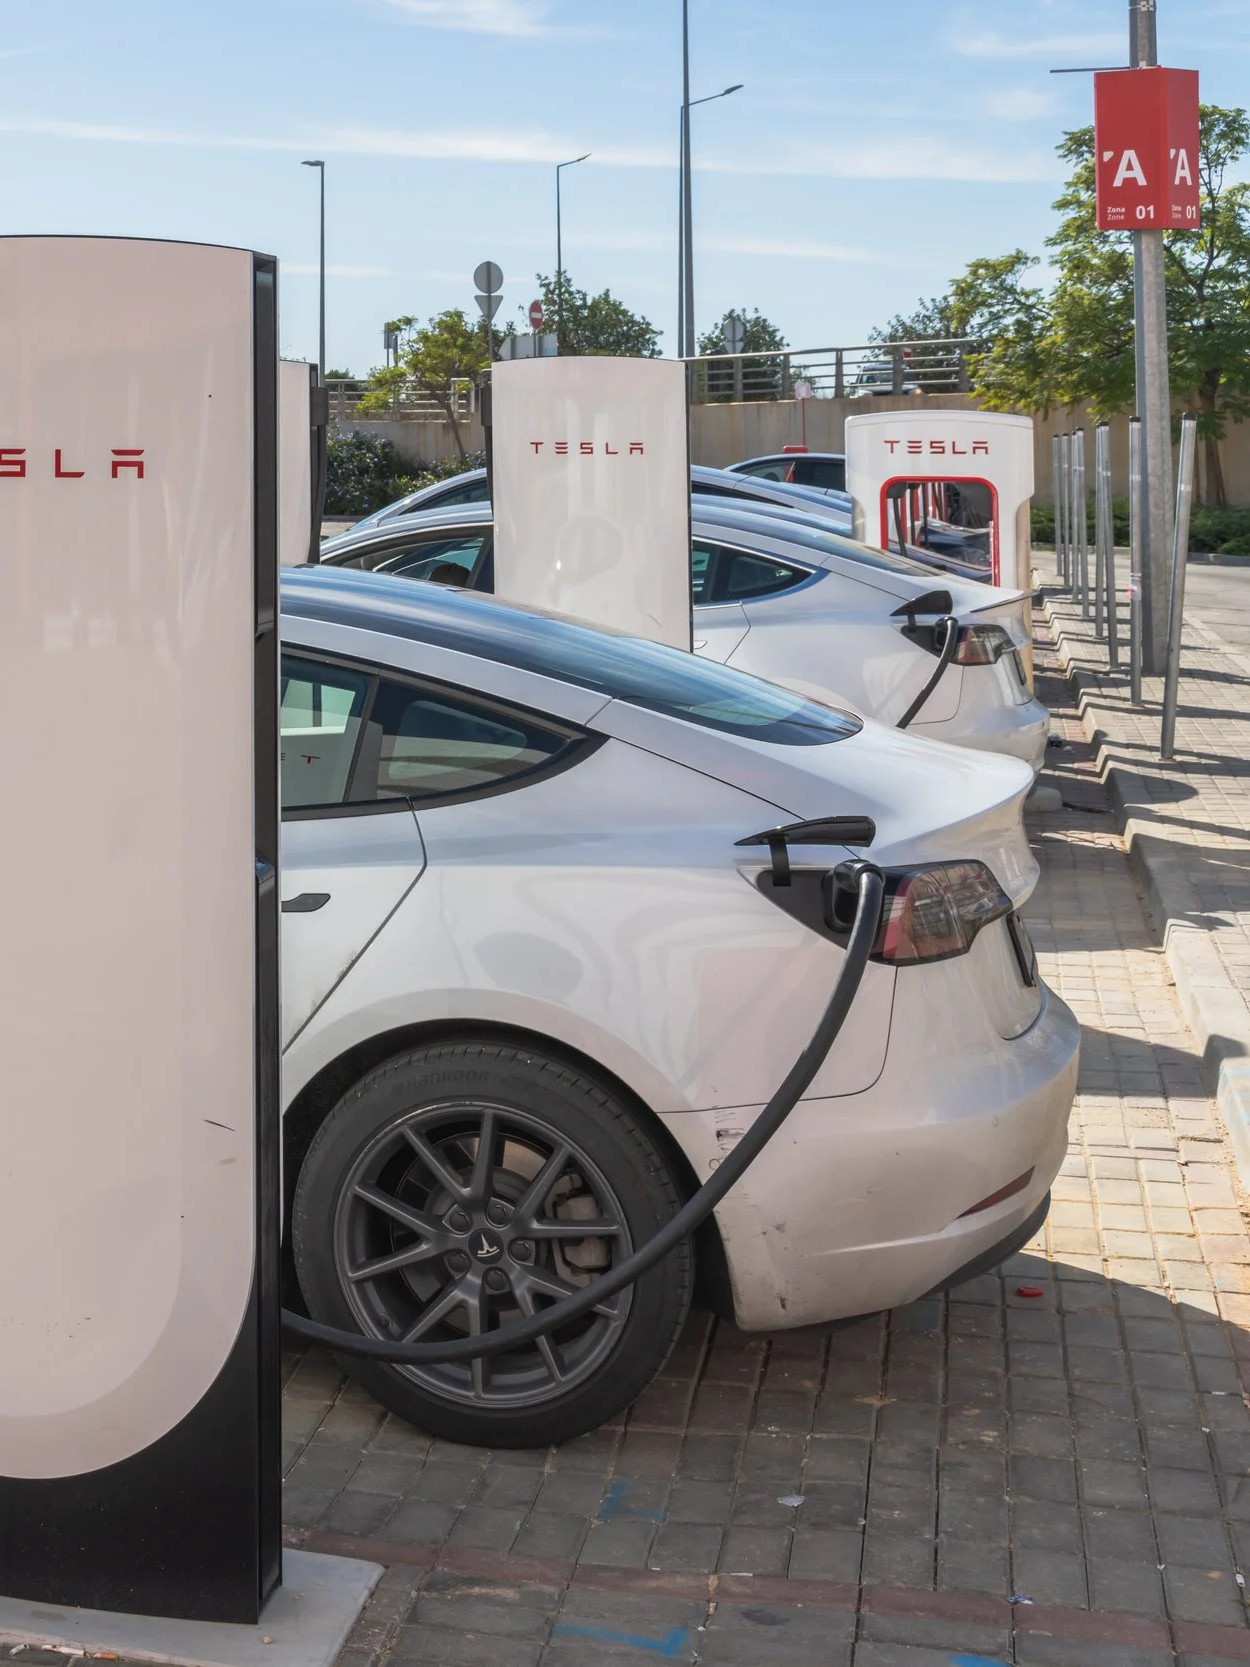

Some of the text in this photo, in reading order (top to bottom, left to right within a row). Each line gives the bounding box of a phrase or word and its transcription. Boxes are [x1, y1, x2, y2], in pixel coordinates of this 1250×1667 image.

[1135, 205, 1155, 219] 01
[1186, 205, 1196, 219] 01
[529, 441, 644, 455] TESLA
[883, 440, 989, 455] TESLA
